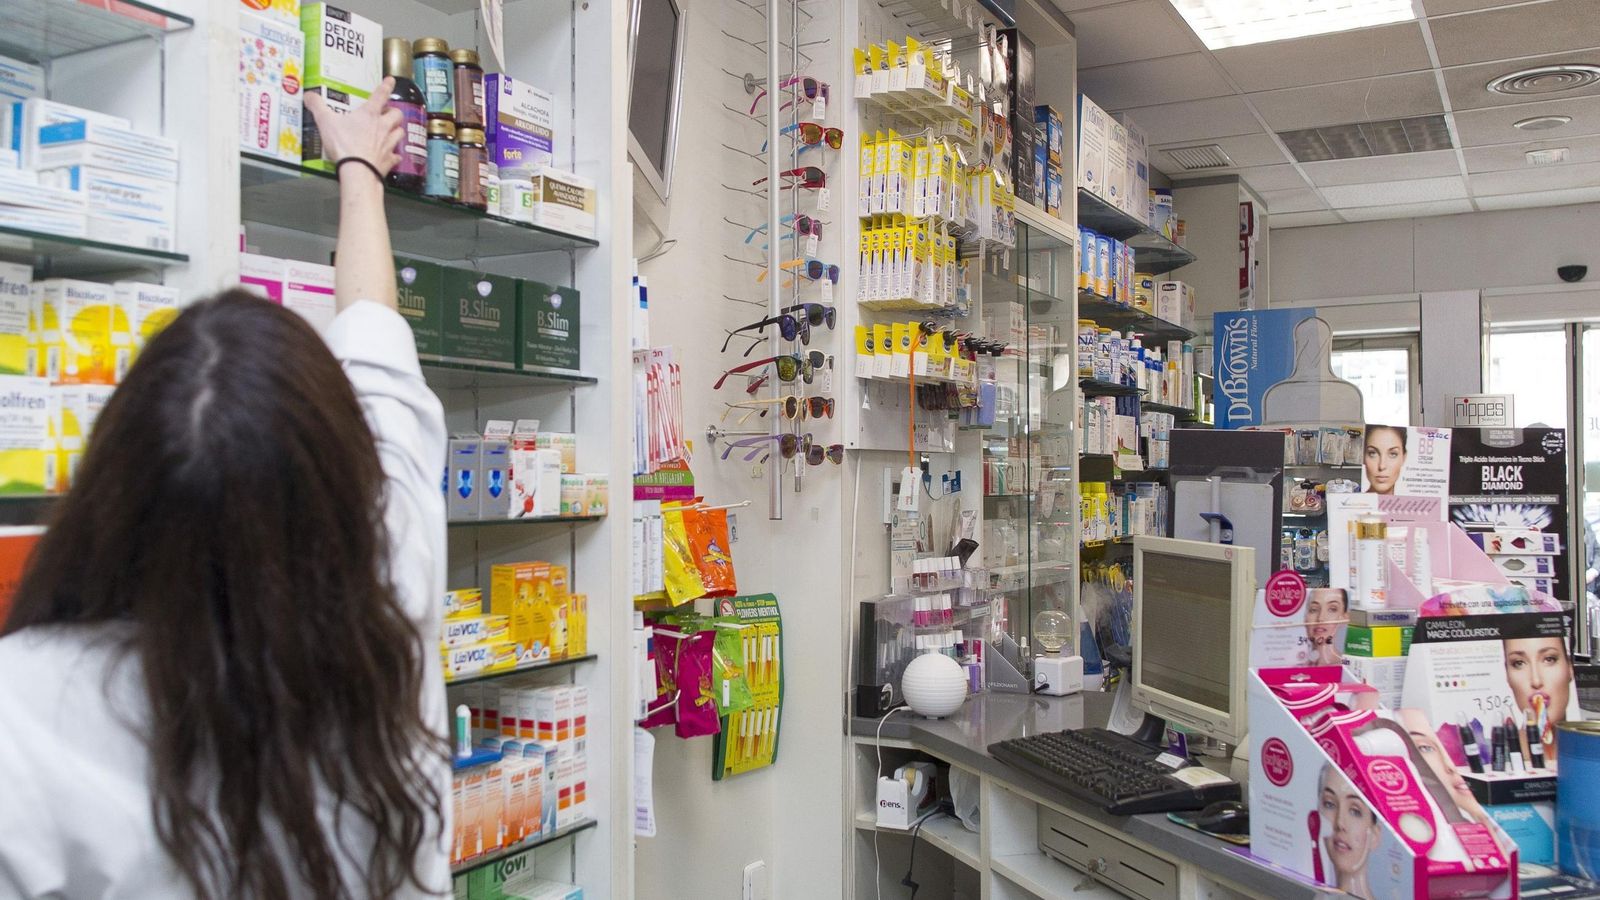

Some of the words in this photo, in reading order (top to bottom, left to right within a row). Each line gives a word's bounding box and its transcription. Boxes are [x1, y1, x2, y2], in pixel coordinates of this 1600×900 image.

[325, 20, 365, 44] DETOXI
[325, 33, 365, 59] DREN
[503, 148, 522, 160] forte
[459, 298, 501, 321] B.Slim
[537, 310, 569, 331] B.Slim
[1250, 339, 1259, 371] Natural
[1455, 398, 1504, 425] nippes
[1481, 465, 1524, 482] BLACK
[1481, 481, 1524, 490] DIAMOND
[1427, 629, 1451, 639] MAGIC
[1451, 627, 1500, 639] COLOURSTICK
